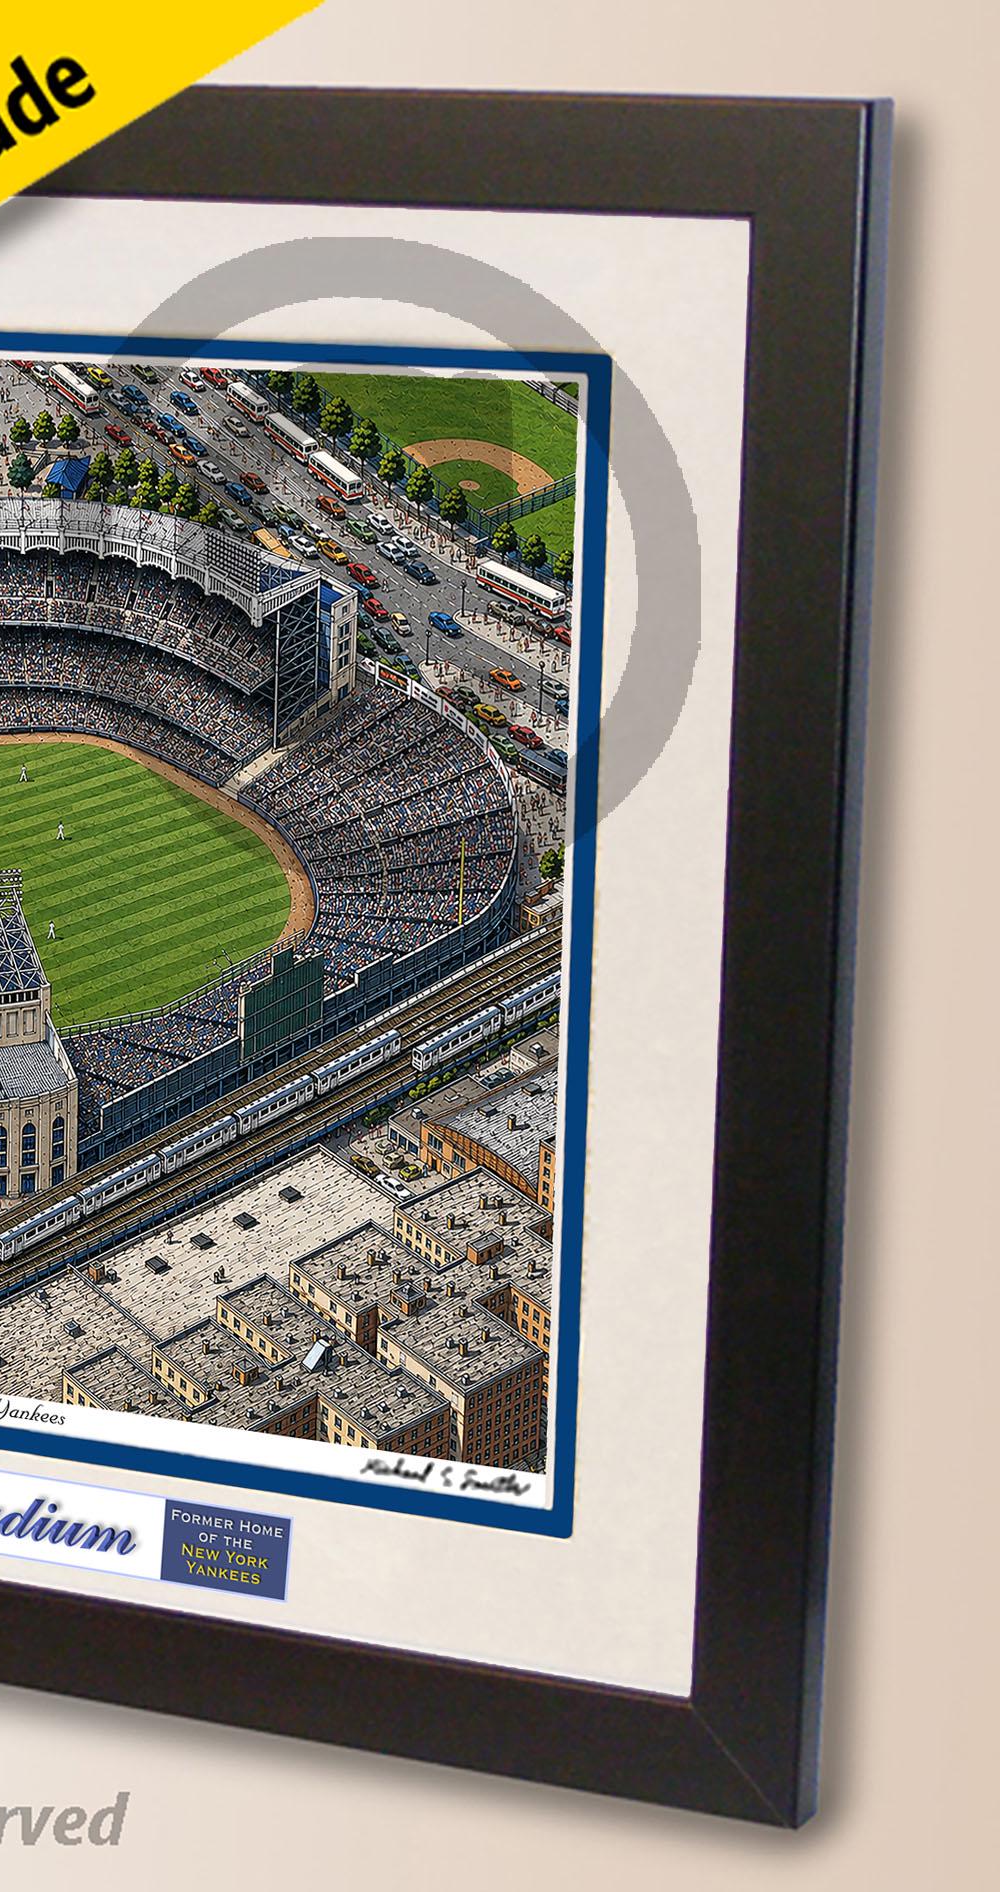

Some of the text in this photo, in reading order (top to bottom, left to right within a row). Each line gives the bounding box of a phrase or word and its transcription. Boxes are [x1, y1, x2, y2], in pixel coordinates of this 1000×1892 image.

[171, 1508, 284, 1539] FORMER HOME
[223, 1535, 253, 1550] THE
[181, 1543, 269, 1569] NEW YORK
[186, 1560, 262, 1585] YANKEES
